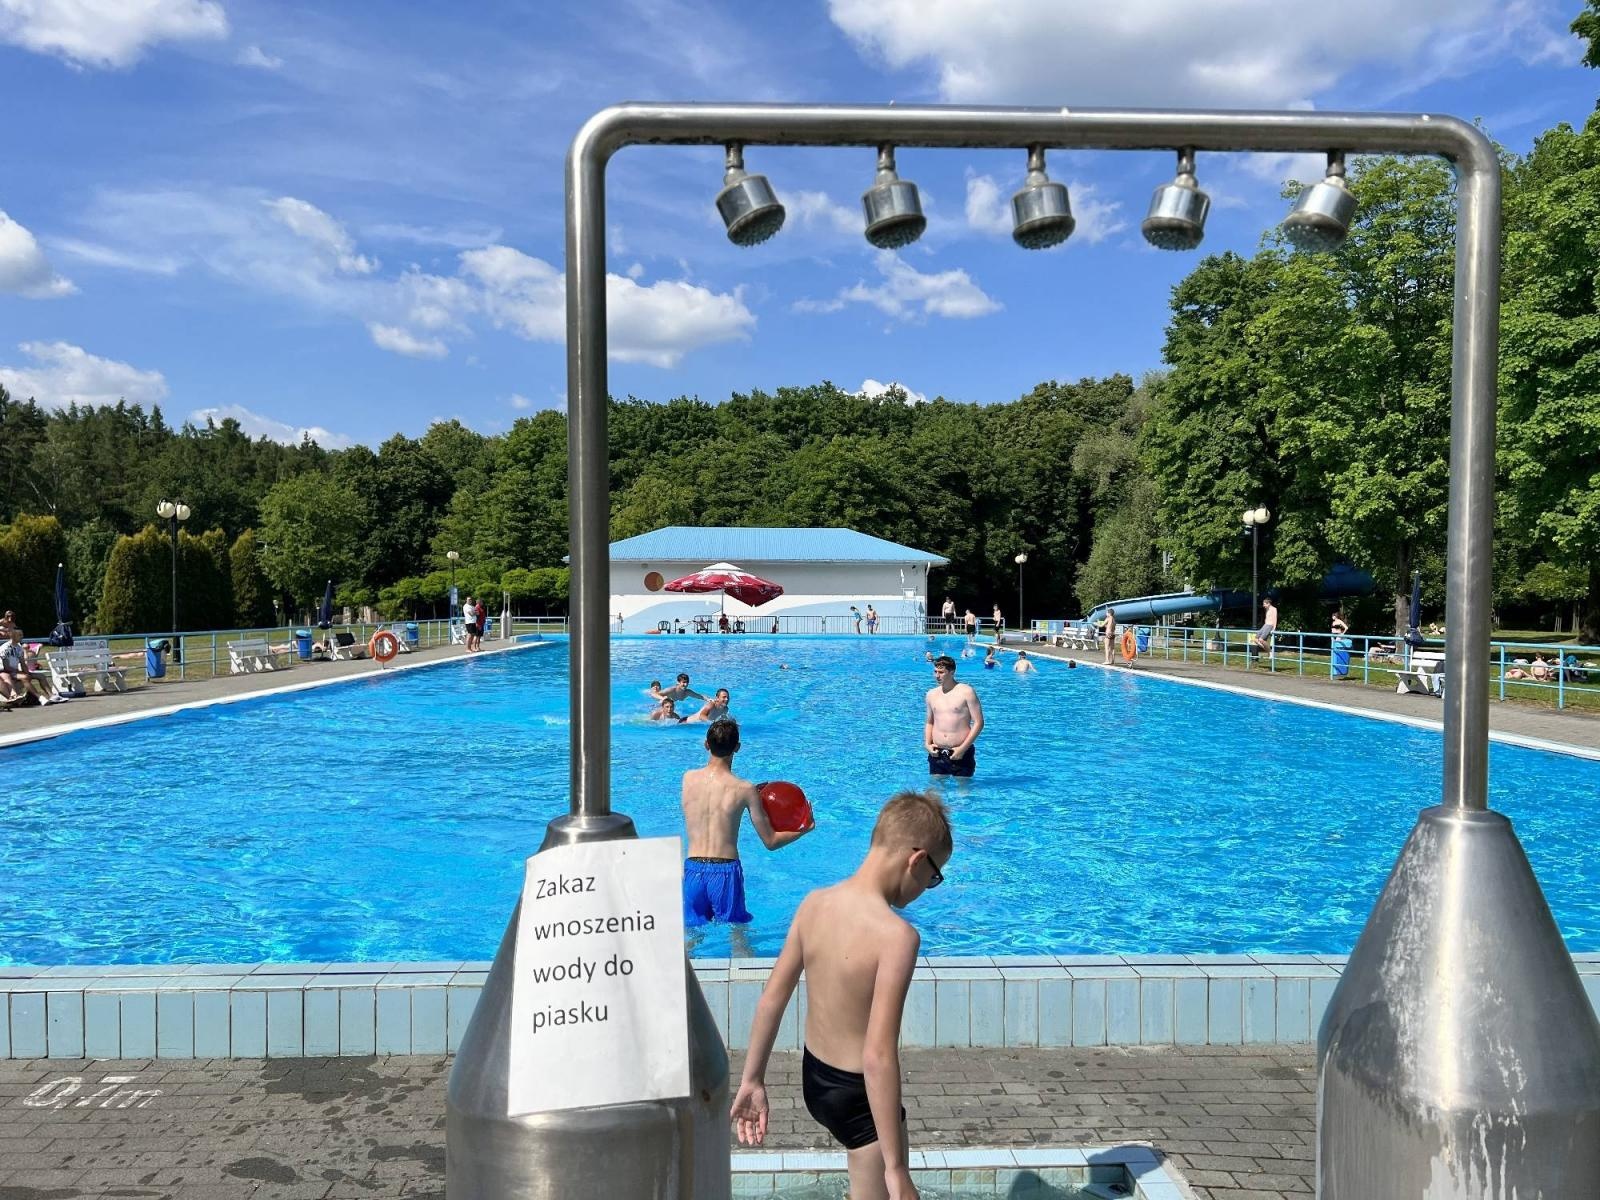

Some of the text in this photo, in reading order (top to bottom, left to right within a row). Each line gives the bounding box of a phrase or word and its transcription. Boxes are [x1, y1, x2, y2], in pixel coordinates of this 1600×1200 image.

[535, 874, 596, 900] Zakaz
[533, 910, 656, 942] wnoszenia
[533, 953, 635, 984] wody do
[532, 1000, 609, 1034] piasku
